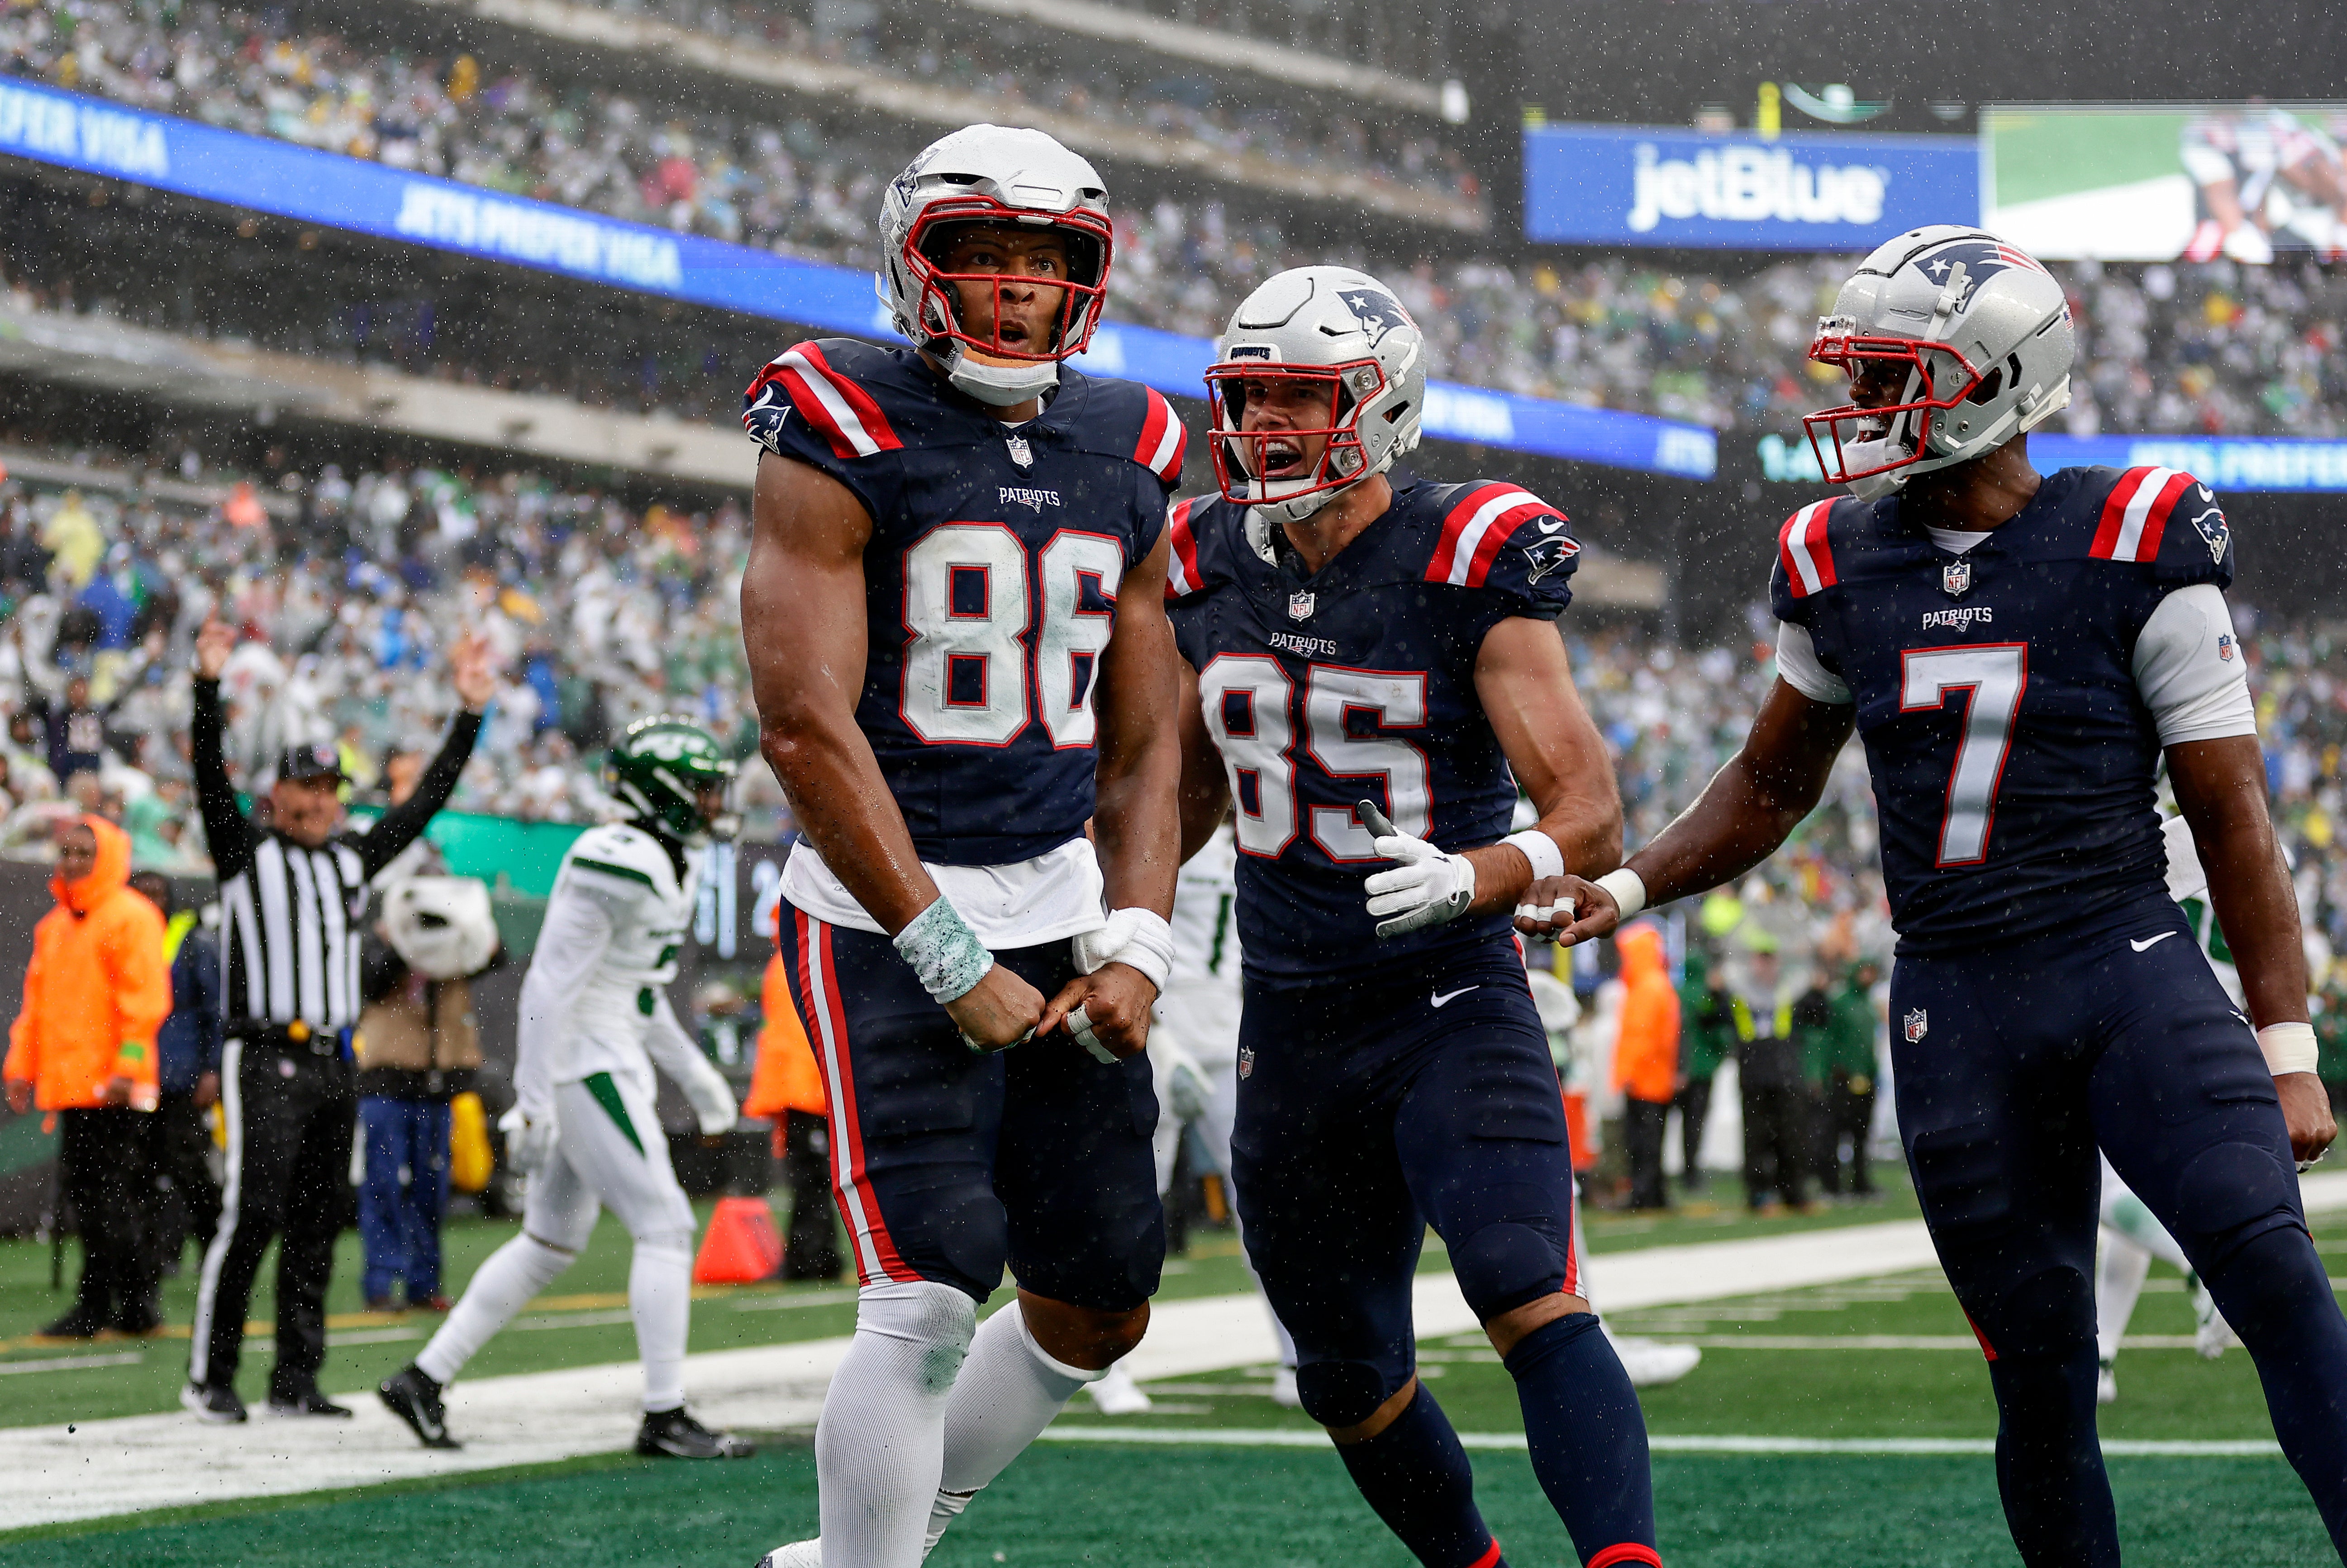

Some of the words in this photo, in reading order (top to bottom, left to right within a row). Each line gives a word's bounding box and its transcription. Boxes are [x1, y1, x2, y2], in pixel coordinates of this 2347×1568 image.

[1628, 142, 1885, 232] jetBlue
[1014, 450, 1030, 462] NFL
[999, 487, 1061, 507] PATRIOTS
[1948, 576, 1965, 589] NFL
[1293, 604, 1309, 615] NFL
[1922, 607, 1992, 630] PATRIOTS
[899, 521, 1124, 750] 86
[1268, 632, 1337, 655] PATRIOTS
[2221, 646, 2233, 659] NFL
[1199, 652, 1435, 864] 85
[1899, 642, 2028, 868] 7
[1909, 1023, 1924, 1037] NFL
